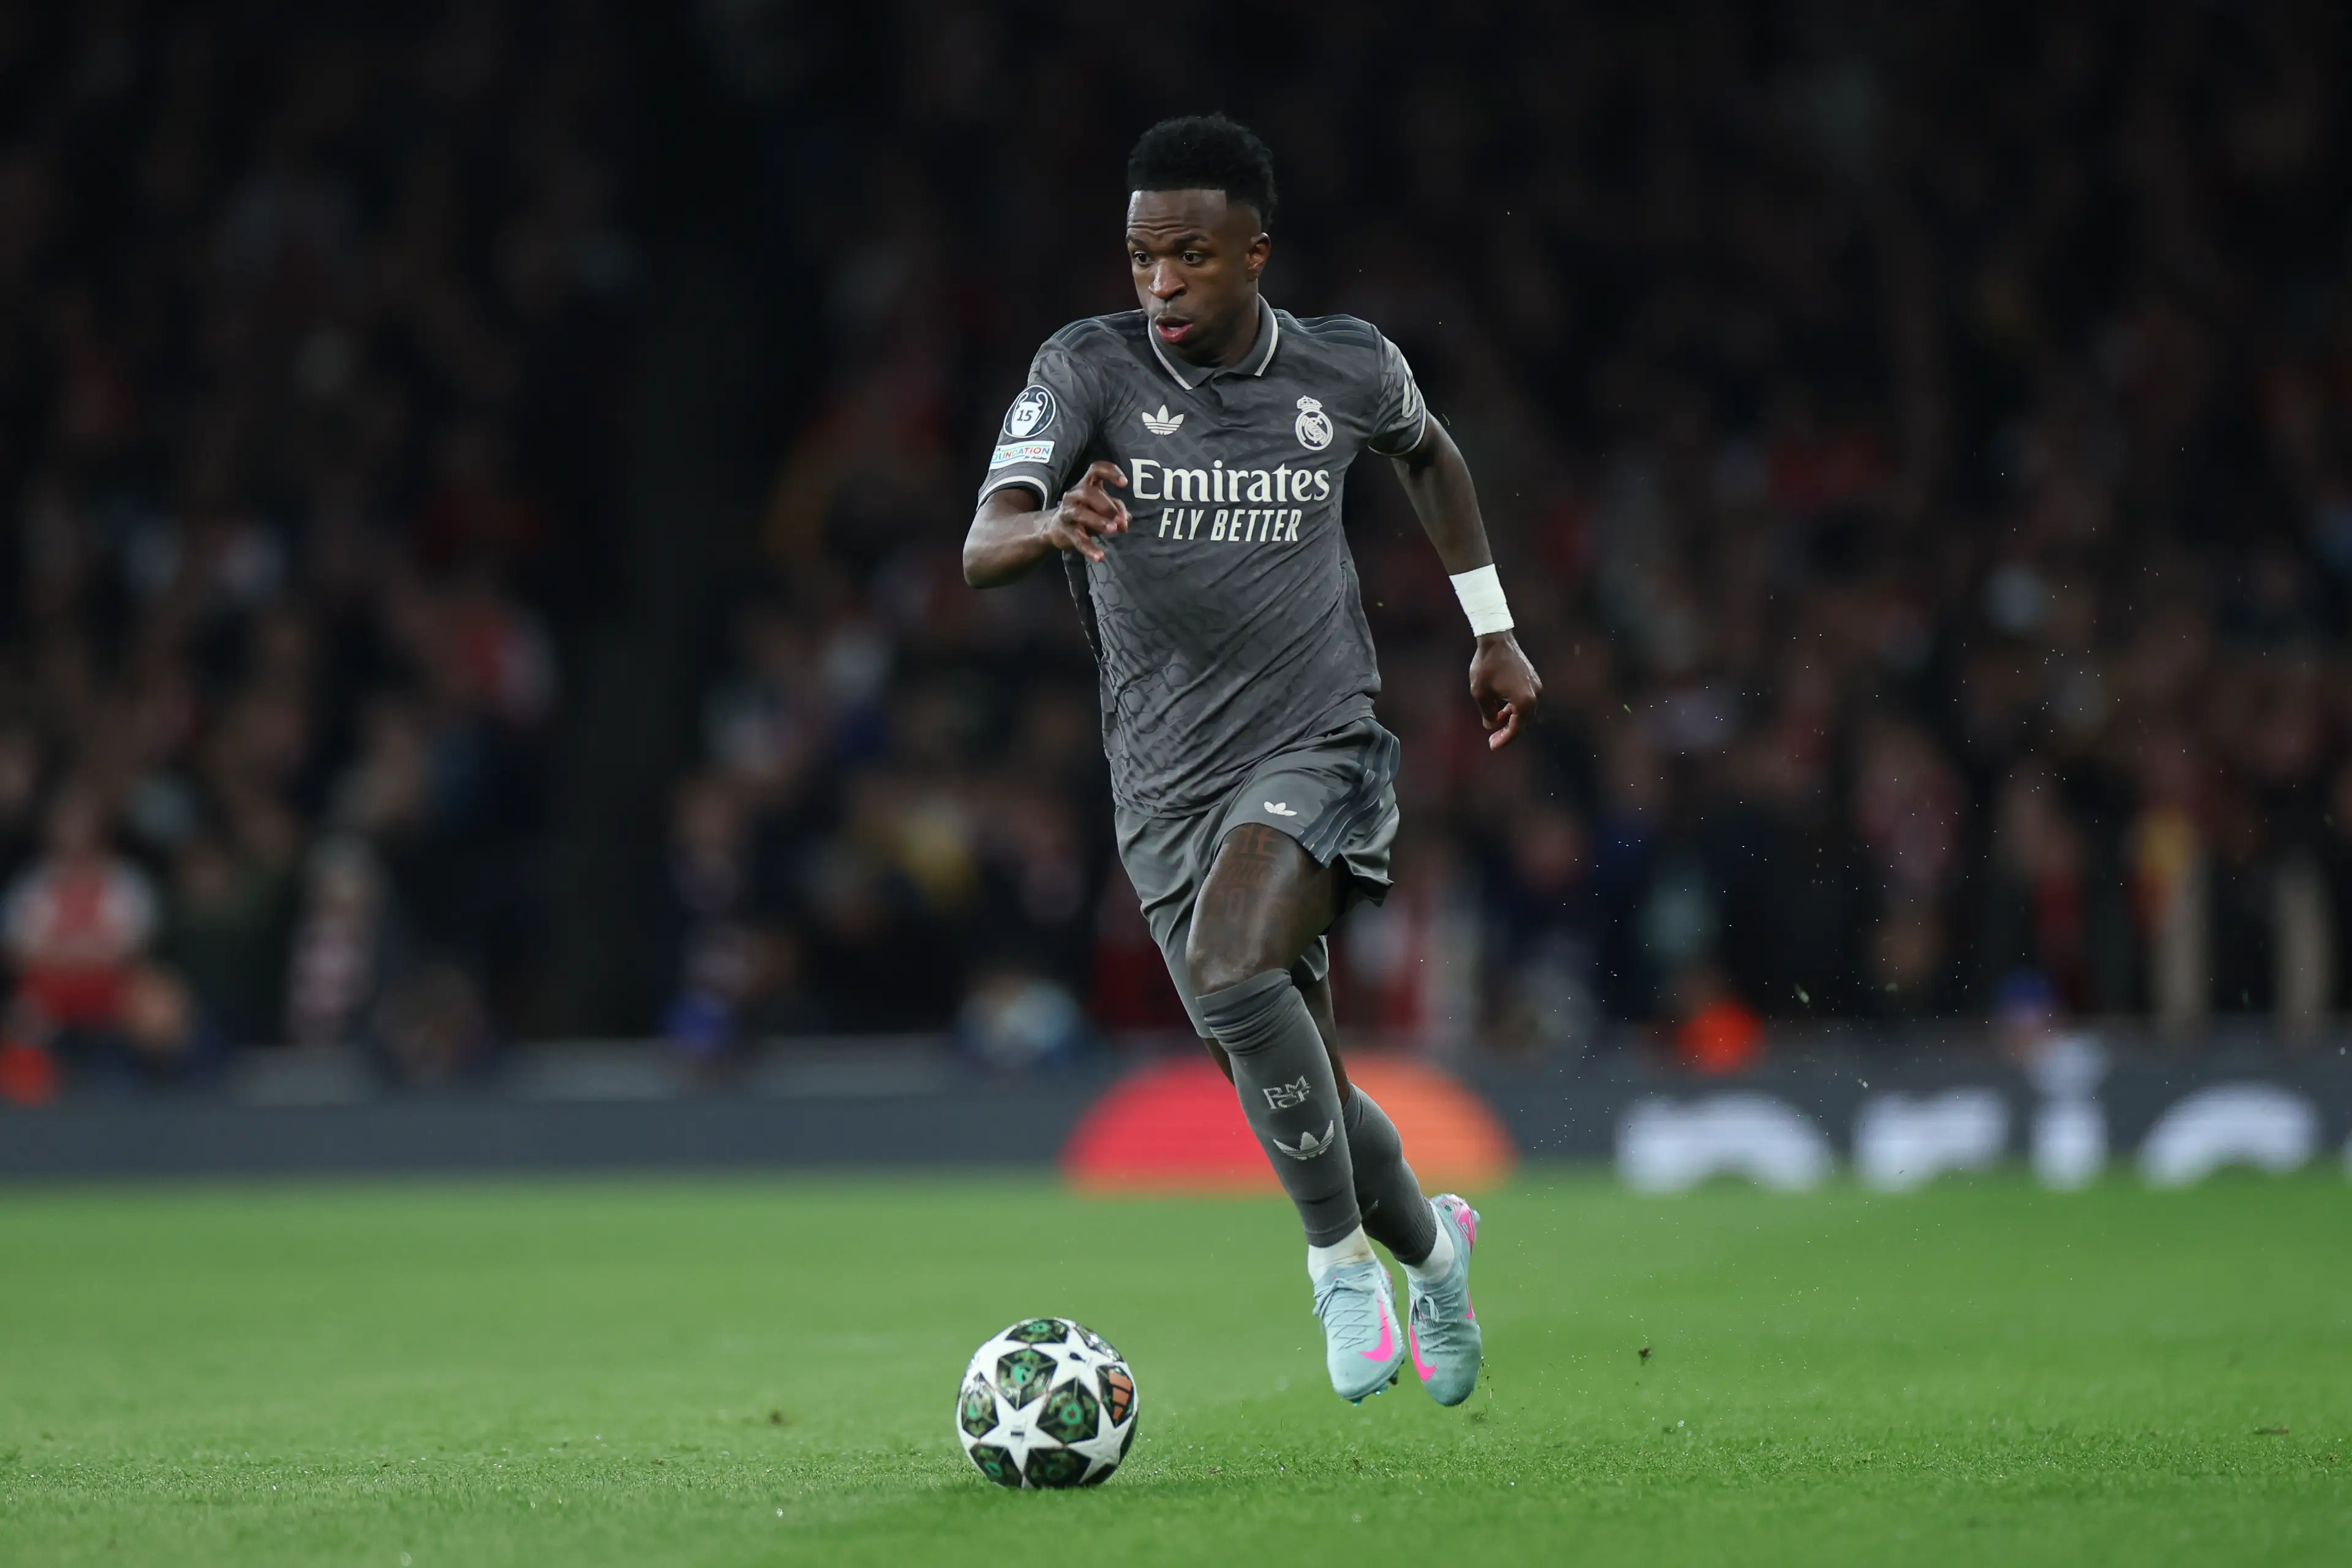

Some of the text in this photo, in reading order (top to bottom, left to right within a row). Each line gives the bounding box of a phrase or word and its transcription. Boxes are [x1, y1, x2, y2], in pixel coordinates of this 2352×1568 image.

[1017, 410, 1033, 421] 15
[1129, 458, 1330, 502] Emirates
[1158, 508, 1302, 542] FLY BETTER
